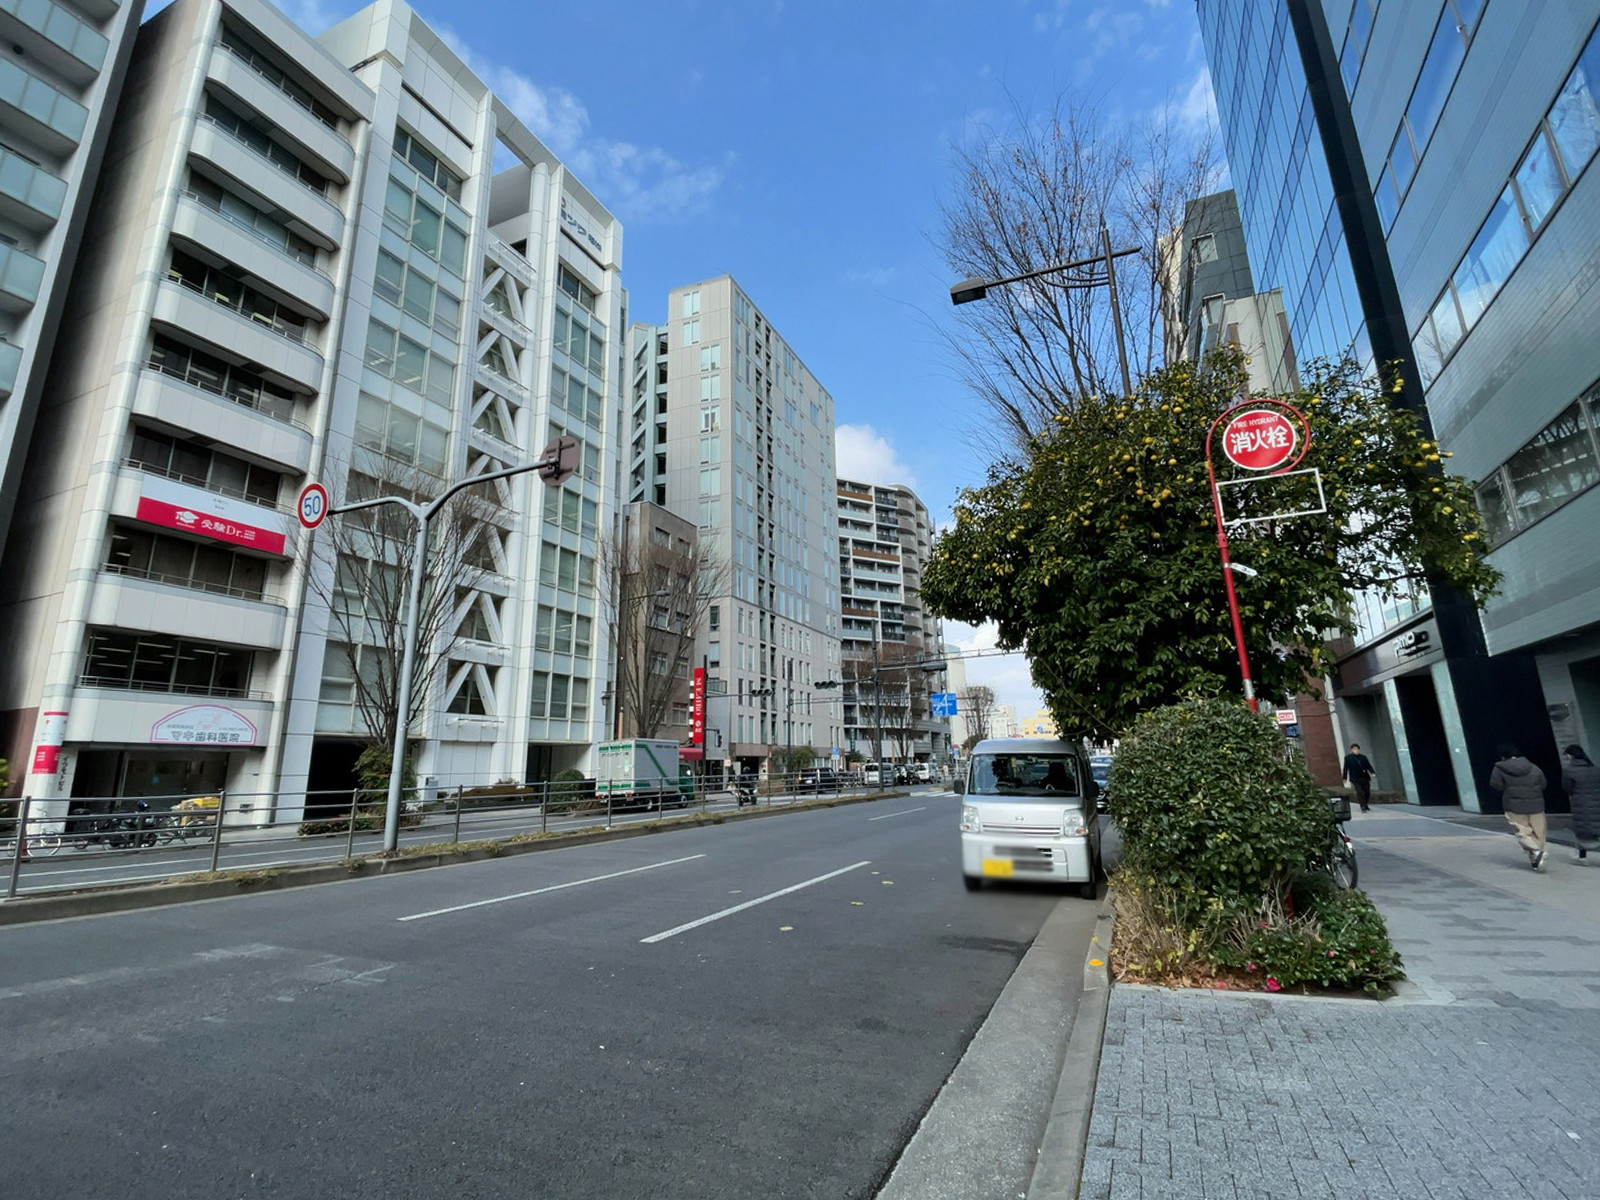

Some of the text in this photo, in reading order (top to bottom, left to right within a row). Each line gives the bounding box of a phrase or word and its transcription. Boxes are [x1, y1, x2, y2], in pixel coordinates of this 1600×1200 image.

[1233, 415, 1279, 429] FIRE HYDRANT
[1230, 425, 1290, 455] 消火栓
[304, 495, 321, 517] 50
[171, 731, 240, 743] マキ歯科医院
